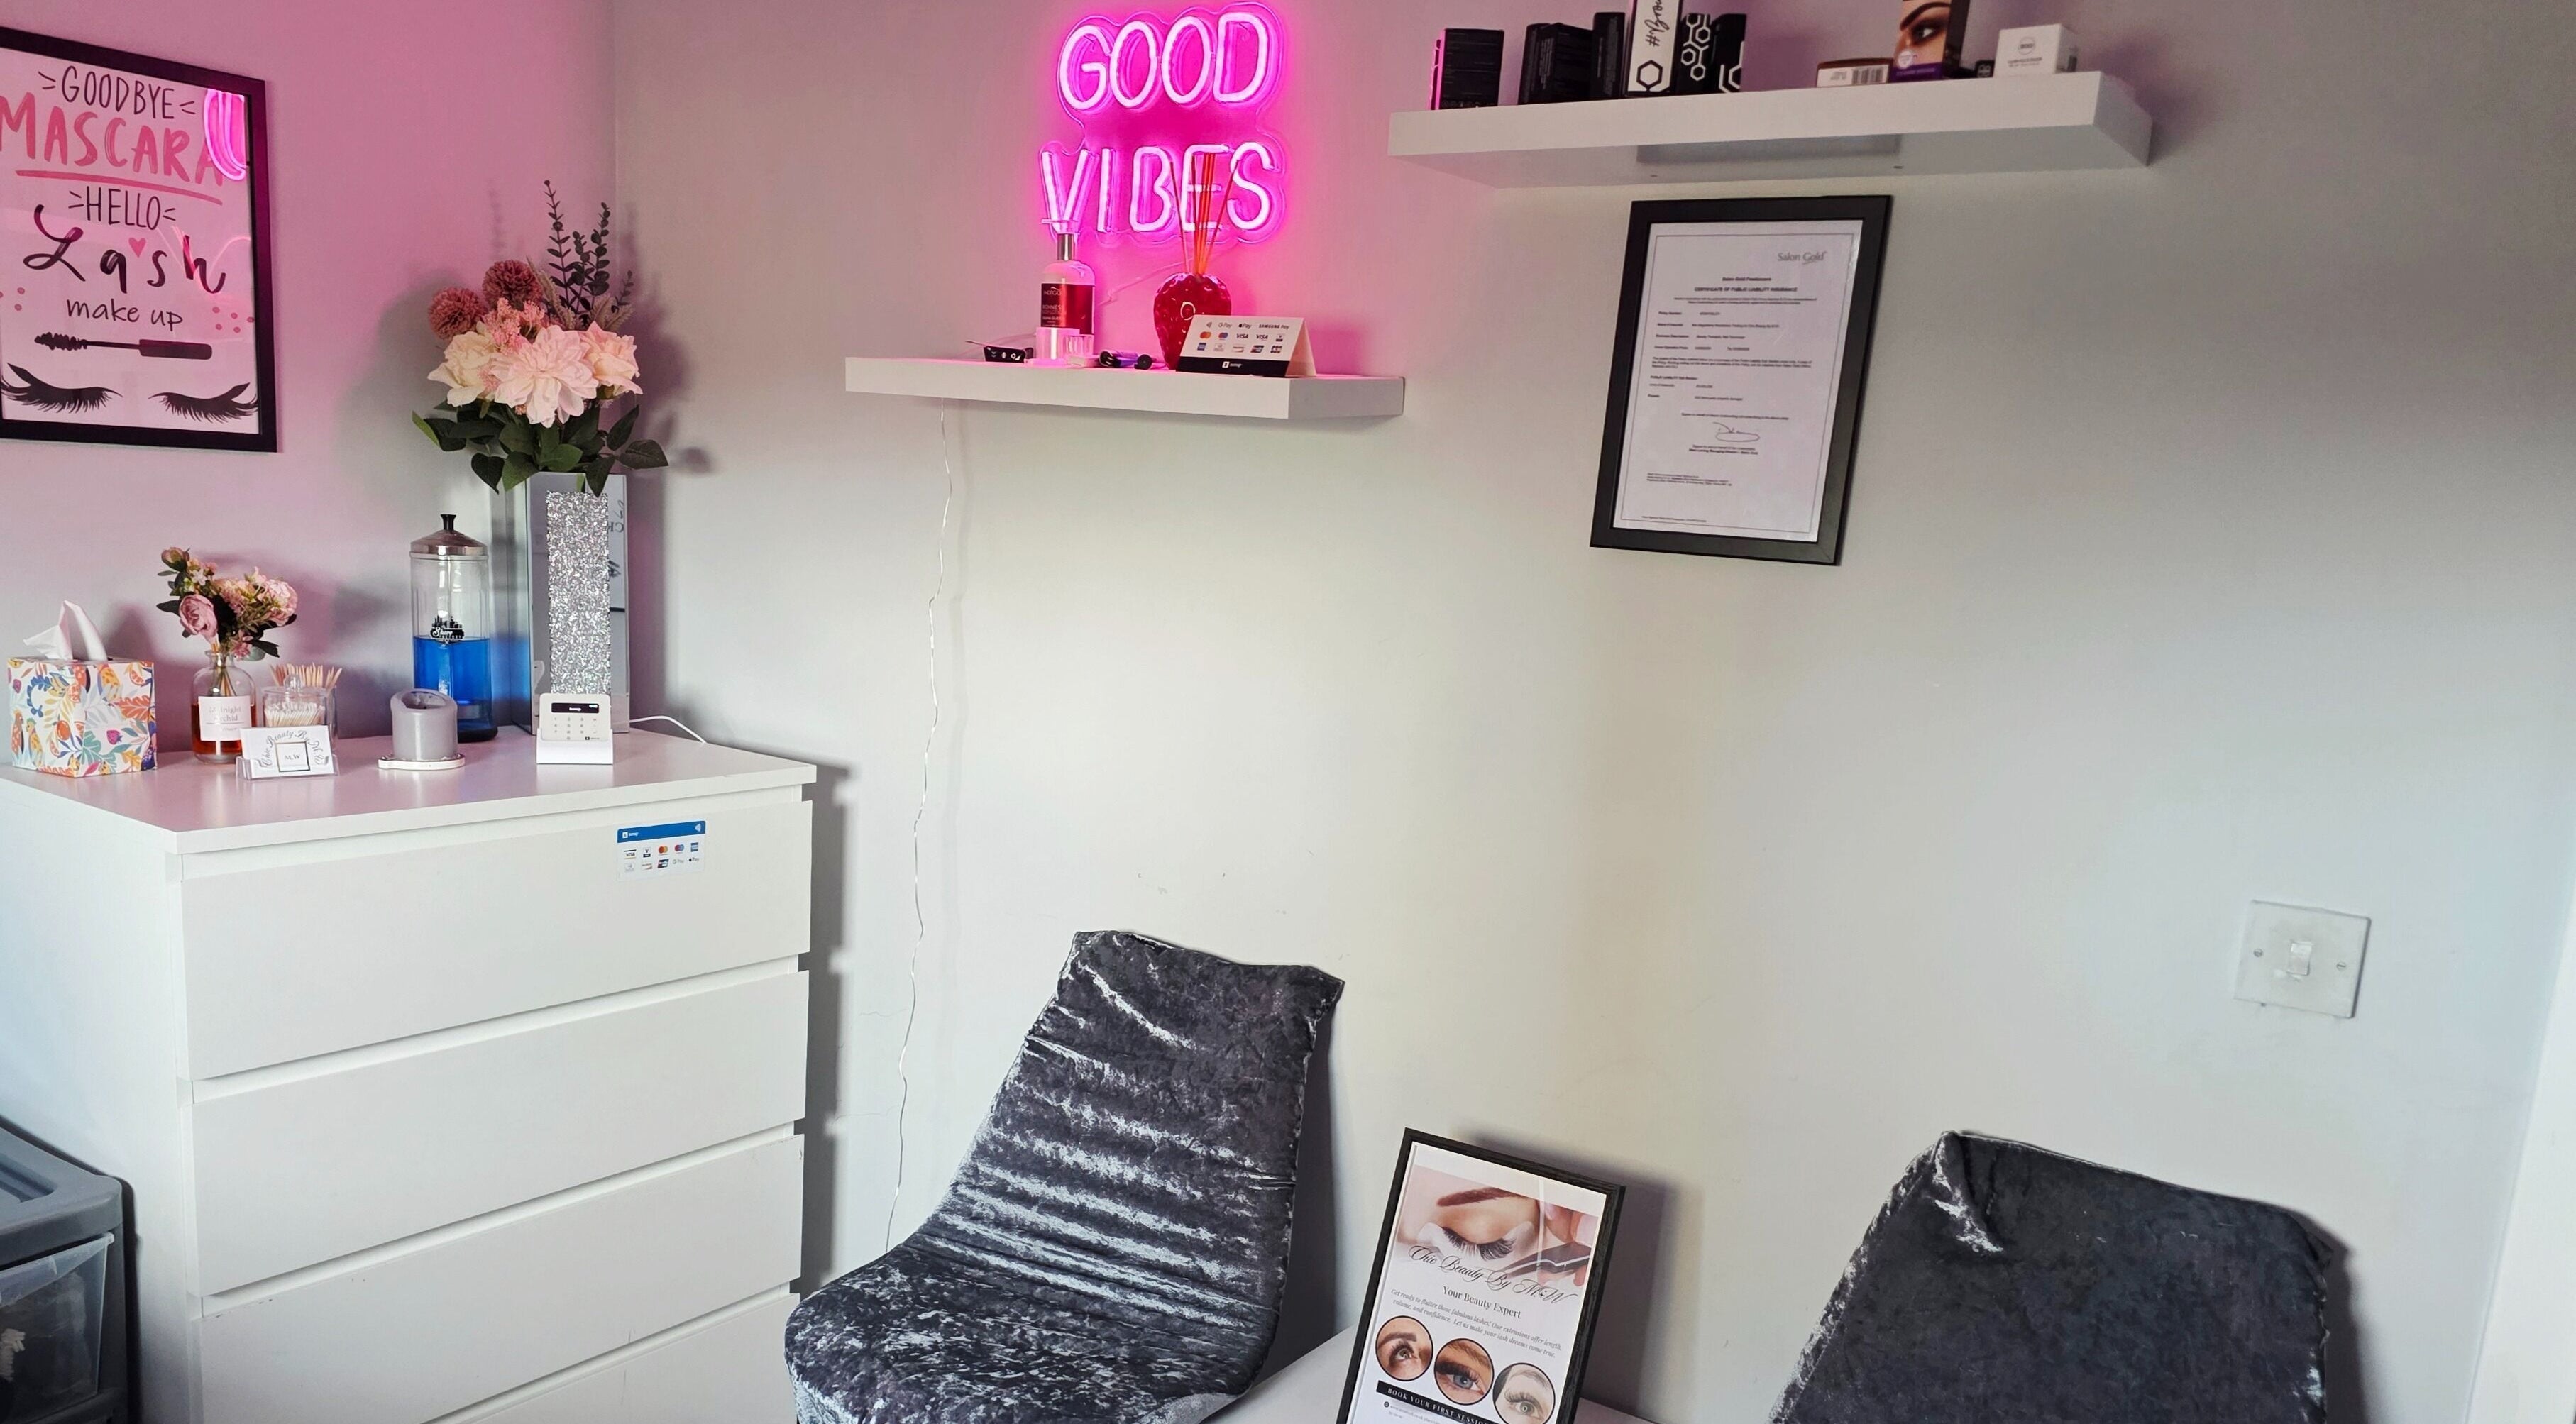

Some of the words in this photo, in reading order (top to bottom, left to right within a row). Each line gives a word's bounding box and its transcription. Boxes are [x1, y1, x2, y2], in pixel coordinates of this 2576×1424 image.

[1058, 11, 1269, 110] GOOD
[61, 65, 175, 120] GOODBYE
[0, 91, 225, 187] MASCARA
[85, 185, 162, 231] HELLO
[1040, 140, 1276, 233] VIBES
[23, 204, 227, 295] Lash
[1777, 251, 1801, 262] Salon
[1802, 251, 1825, 263] Gold
[66, 297, 141, 324] make
[150, 307, 184, 332] up
[265, 730, 295, 749] Beauty
[295, 729, 311, 743] By
[1408, 1245, 1438, 1264] Chic
[1438, 1255, 1485, 1282] Beauty
[1484, 1270, 1512, 1291] By
[1399, 1291, 1414, 1302] ready
[1451, 1308, 1473, 1320] fabulous
[1502, 1324, 1530, 1340] extensions
[1531, 1335, 1545, 1344] offer
[1443, 1286, 1463, 1300] Your
[1463, 1293, 1492, 1310] Beauty
[1493, 1302, 1521, 1319] Expert
[1412, 1304, 1424, 1313] and
[1453, 1318, 1463, 1327] Let
[1470, 1324, 1484, 1335] make
[1484, 1329, 1497, 1340] your
[1497, 1331, 1508, 1342] lash
[1508, 1336, 1529, 1349] dreams
[1529, 1345, 1543, 1353] come
[1387, 1388, 1408, 1400] BOOK
[1410, 1396, 1430, 1408] YOUR
[1432, 1403, 1455, 1417] FIRST
